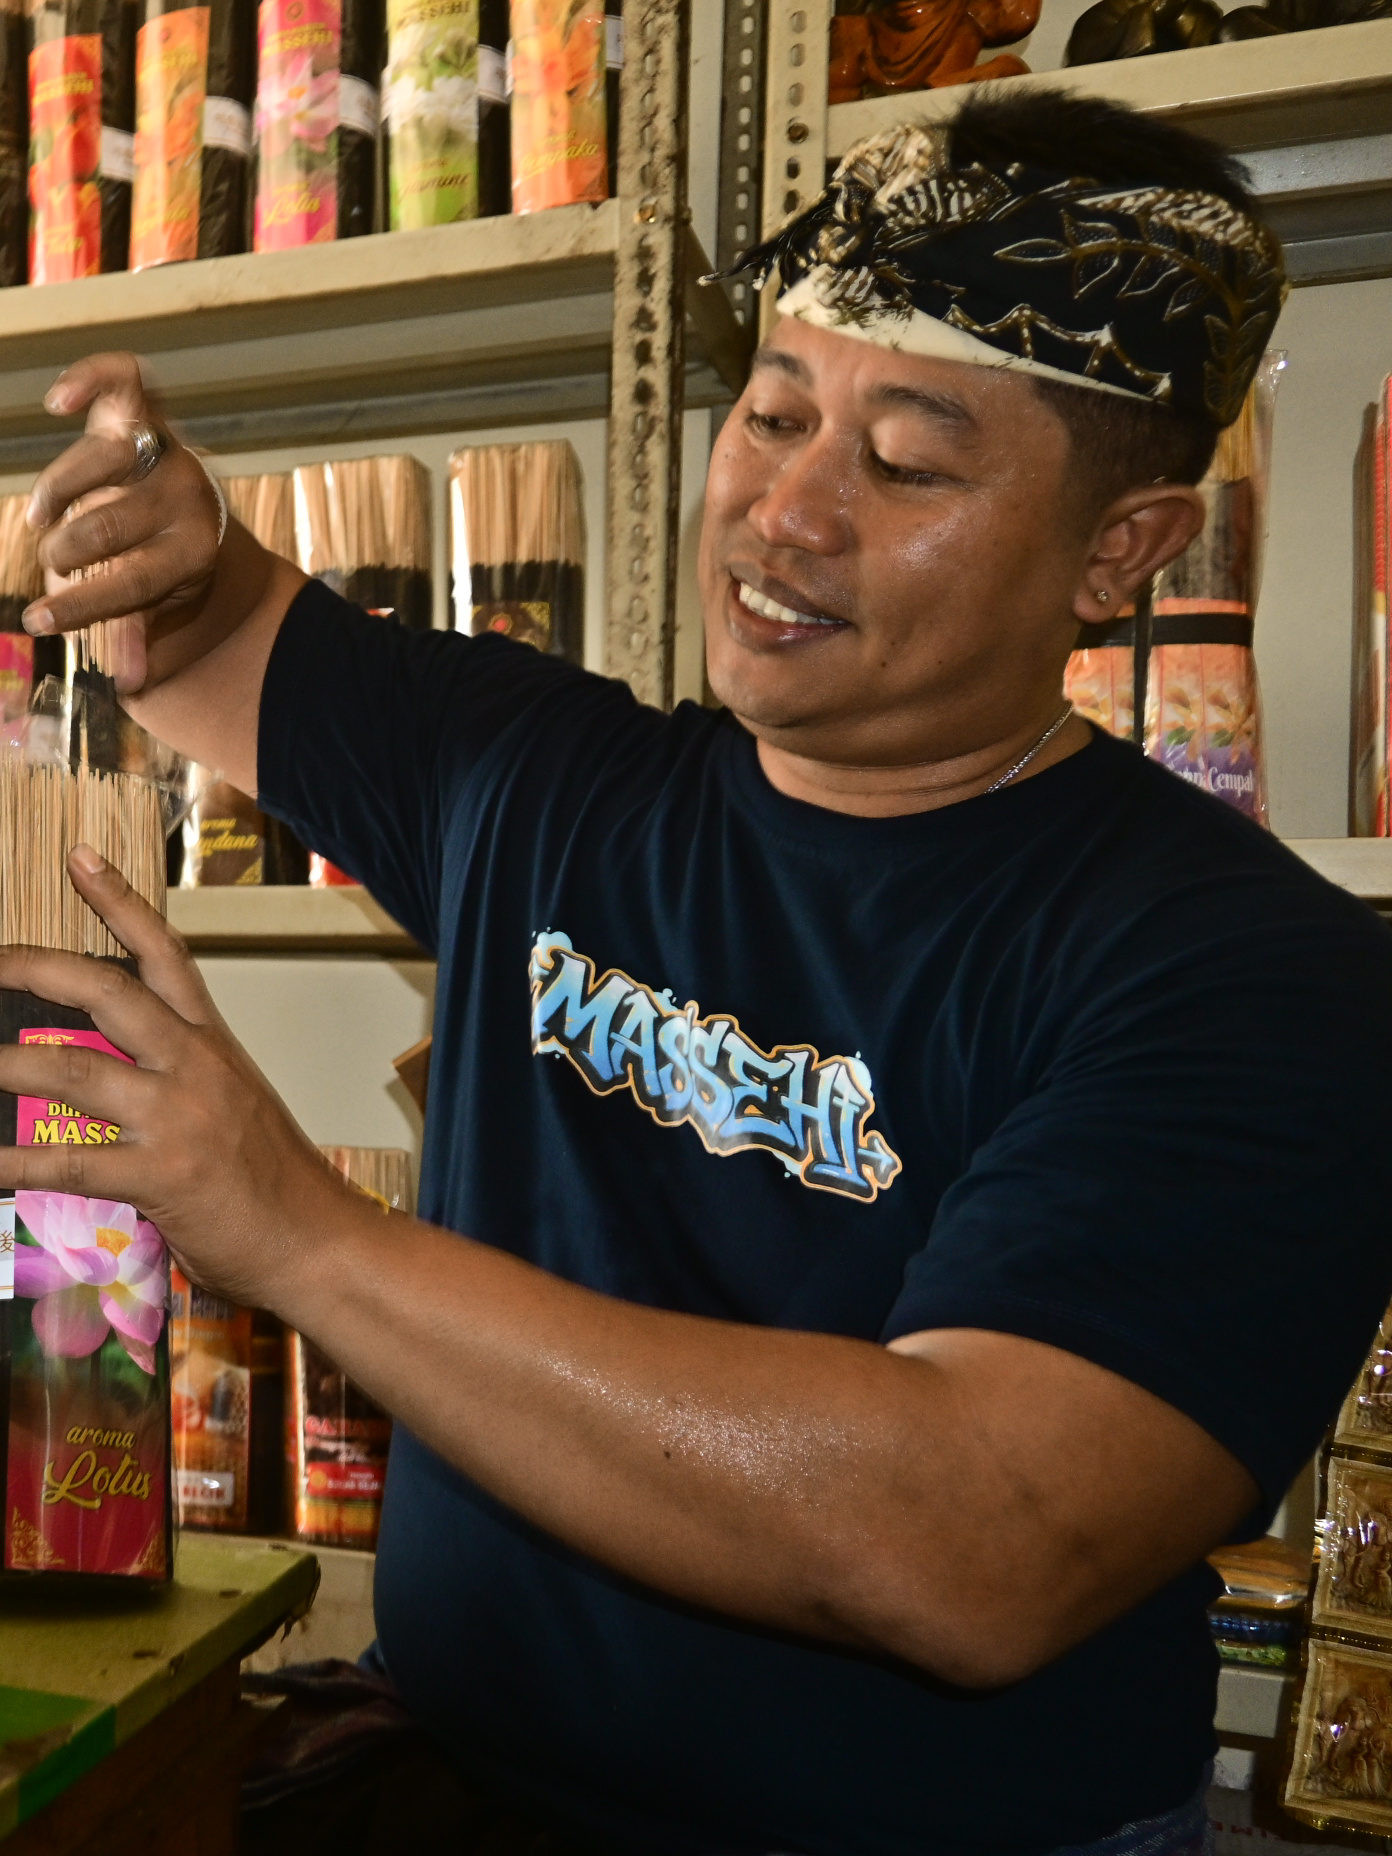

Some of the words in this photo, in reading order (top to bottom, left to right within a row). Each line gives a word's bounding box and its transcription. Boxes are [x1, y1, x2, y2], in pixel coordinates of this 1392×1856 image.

[529, 944, 883, 1203] MASSEHI
[31, 1119, 121, 1145] MASS
[65, 1424, 136, 1449] aroma
[42, 1448, 152, 1510] Lotus
